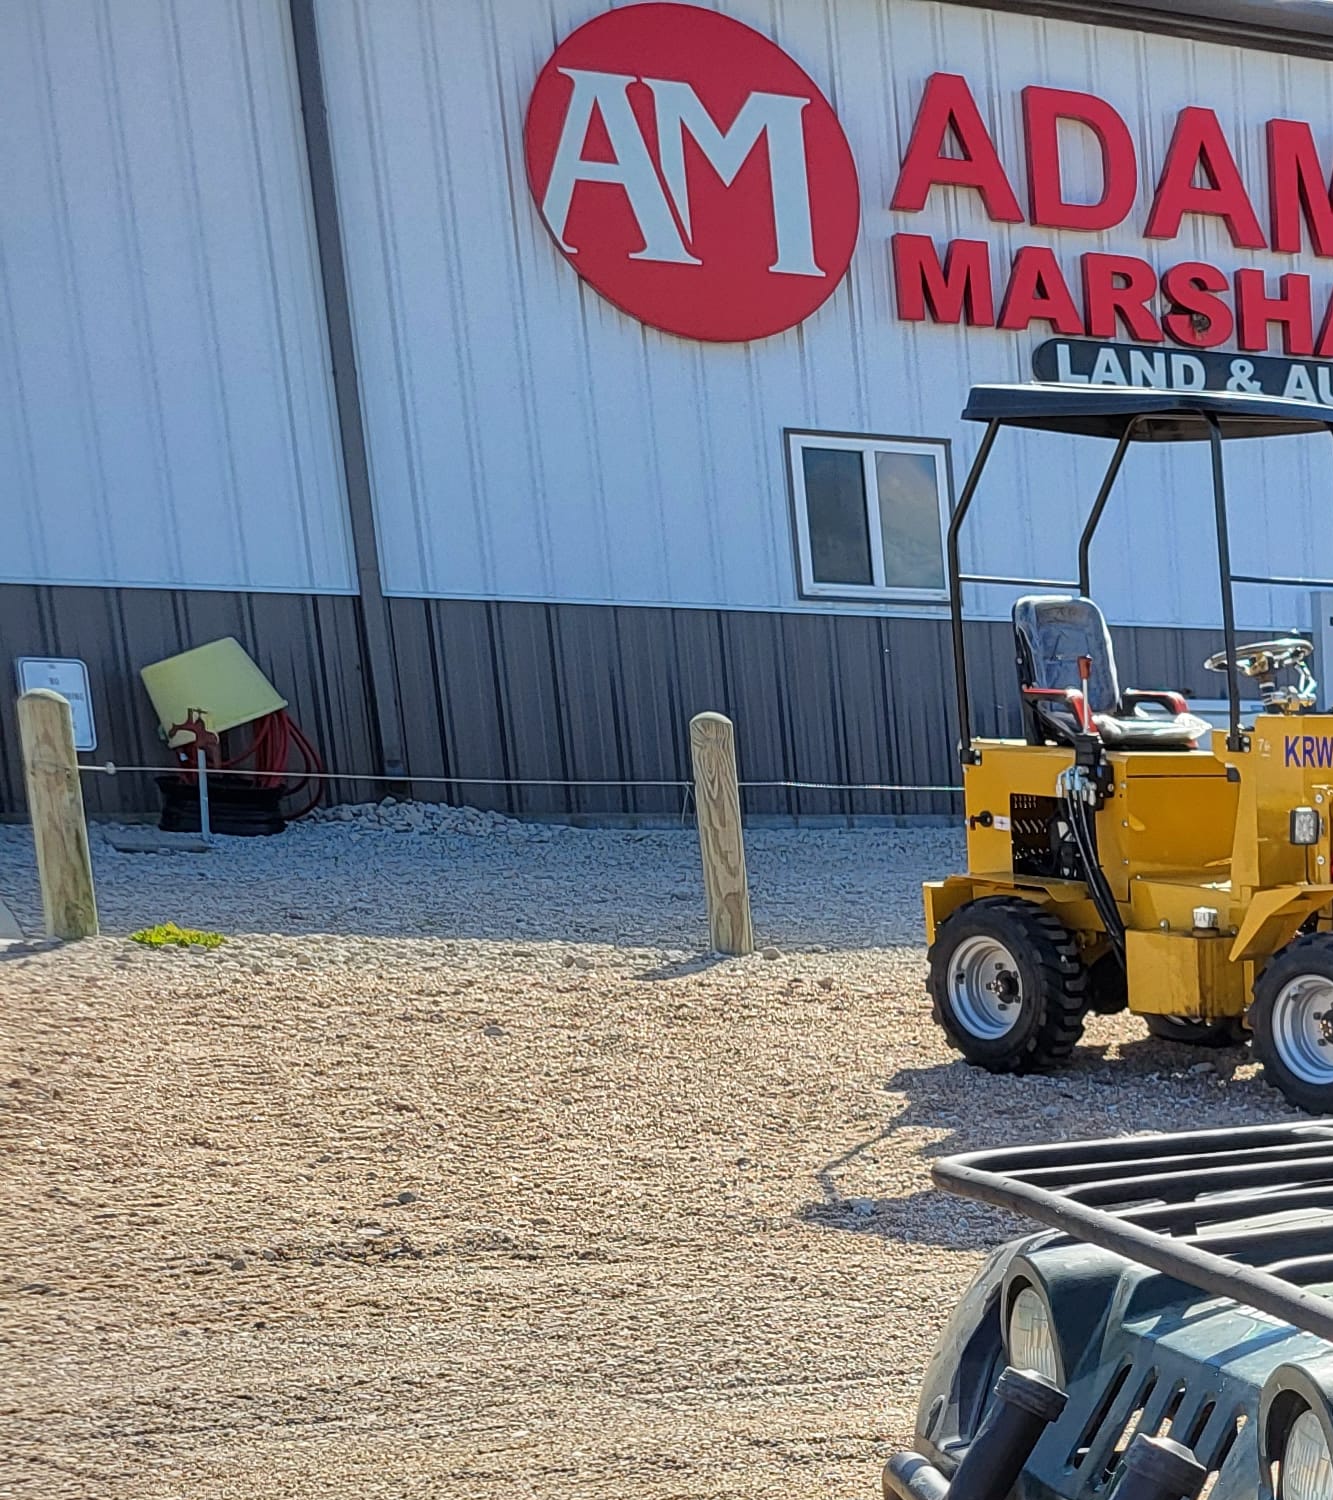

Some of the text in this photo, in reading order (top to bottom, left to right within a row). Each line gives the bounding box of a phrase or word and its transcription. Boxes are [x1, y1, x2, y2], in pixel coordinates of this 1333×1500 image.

[542, 66, 827, 278] AM
[1056, 343, 1207, 392] LAND
[1226, 358, 1263, 394] &
